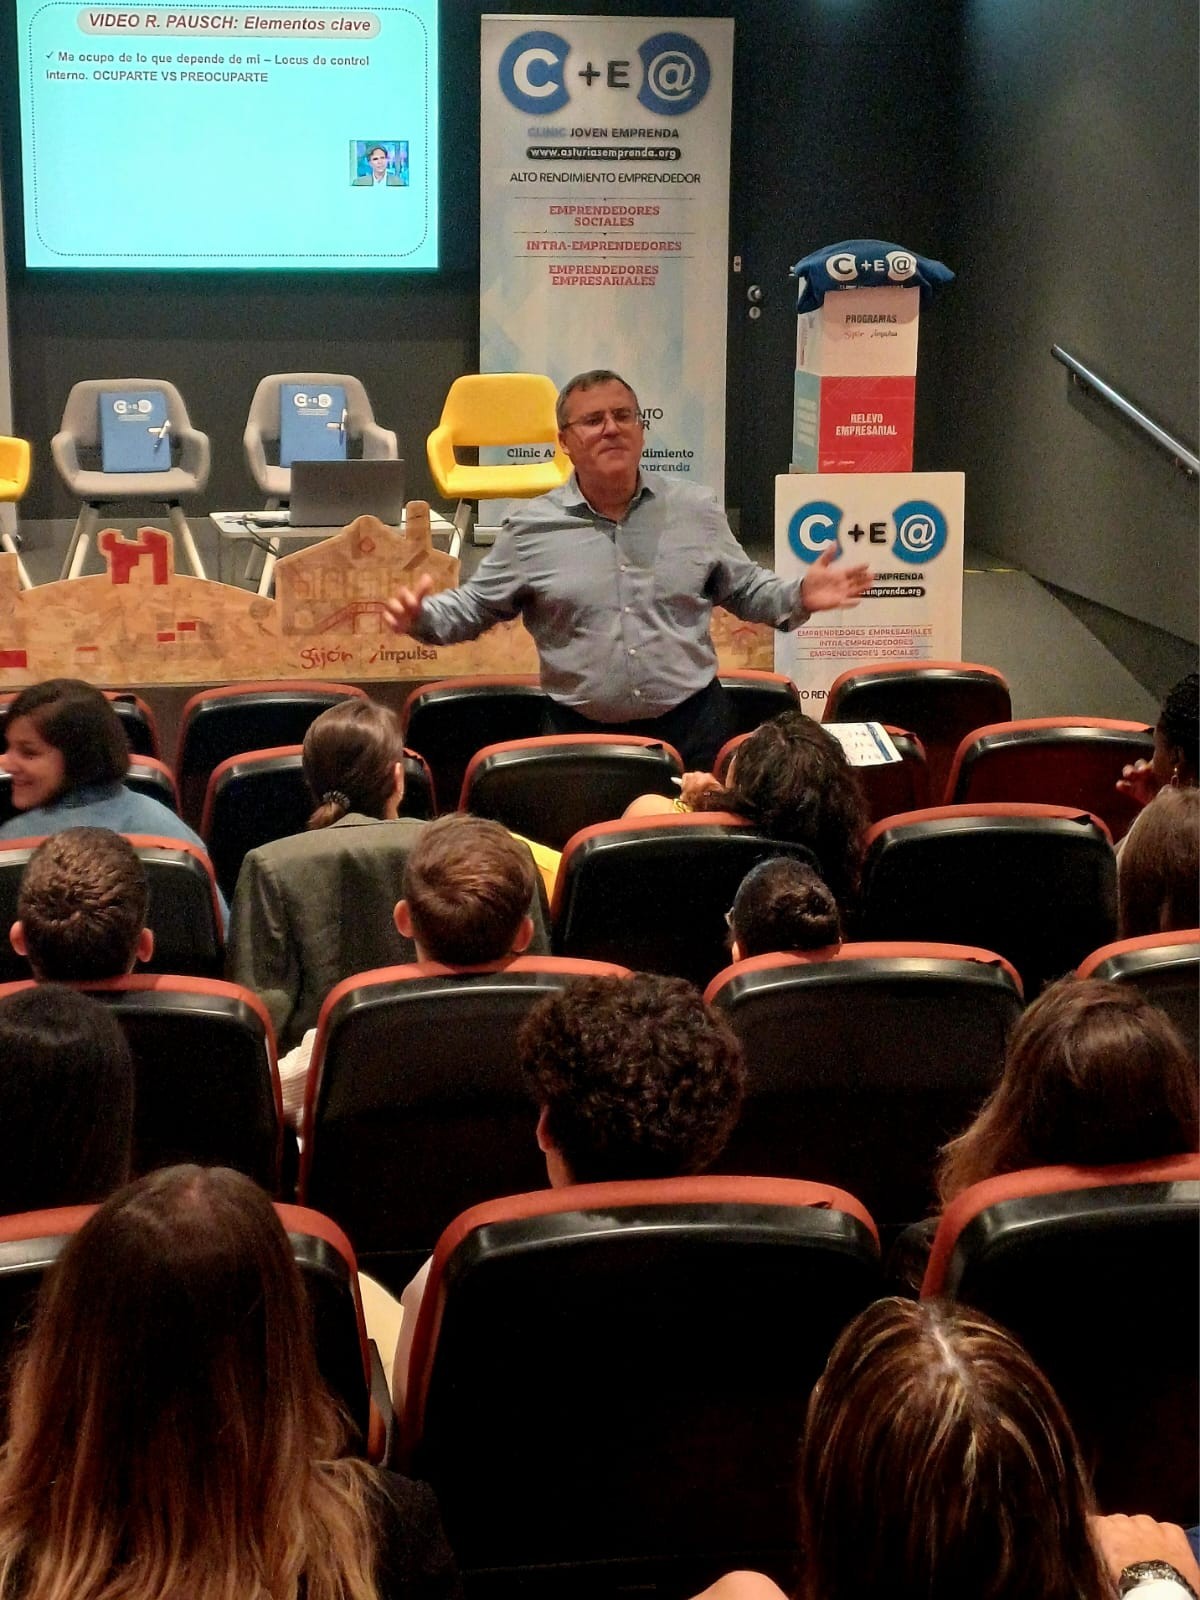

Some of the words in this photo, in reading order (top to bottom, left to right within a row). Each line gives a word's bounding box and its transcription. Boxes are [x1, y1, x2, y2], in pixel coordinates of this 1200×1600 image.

[89, 13, 140, 28] VIDEO
[145, 14, 161, 28] R.
[166, 14, 239, 30] PAUSCH:
[244, 16, 326, 30] Elementos
[331, 17, 371, 31] clave
[78, 54, 115, 64] ocupo
[119, 52, 133, 62] de
[136, 52, 147, 63] lo
[151, 55, 172, 65] que
[176, 53, 225, 65] depende
[228, 53, 242, 63] de
[274, 54, 309, 65] Locus
[330, 55, 370, 66] control
[93, 70, 158, 81] OCUPARTE
[161, 71, 177, 81] VS
[180, 71, 269, 82] PREOCUPARTE
[570, 127, 608, 138] JOVEN
[611, 128, 680, 138] EMPRENDA
[530, 146, 677, 160] www.asturiasemprenda.org
[509, 172, 538, 183] ALTO
[539, 172, 616, 183] RENDIMIENTO
[618, 172, 701, 184] EMPRENDEDOR
[549, 205, 661, 216] EMPRENDEDORES
[574, 217, 635, 227] SOCIALES
[526, 240, 682, 251] INTRA-EMPRENDEDORES
[548, 264, 659, 275] EMPRENDEDORES
[551, 276, 656, 286] EMPRESARIALES
[845, 314, 897, 324] PROGRAMAS
[850, 413, 884, 424] RELEVO
[835, 424, 898, 436] EMPRESARIAL
[506, 447, 541, 458] Clinic
[641, 448, 694, 458] dimiento
[640, 462, 691, 472] mprenda
